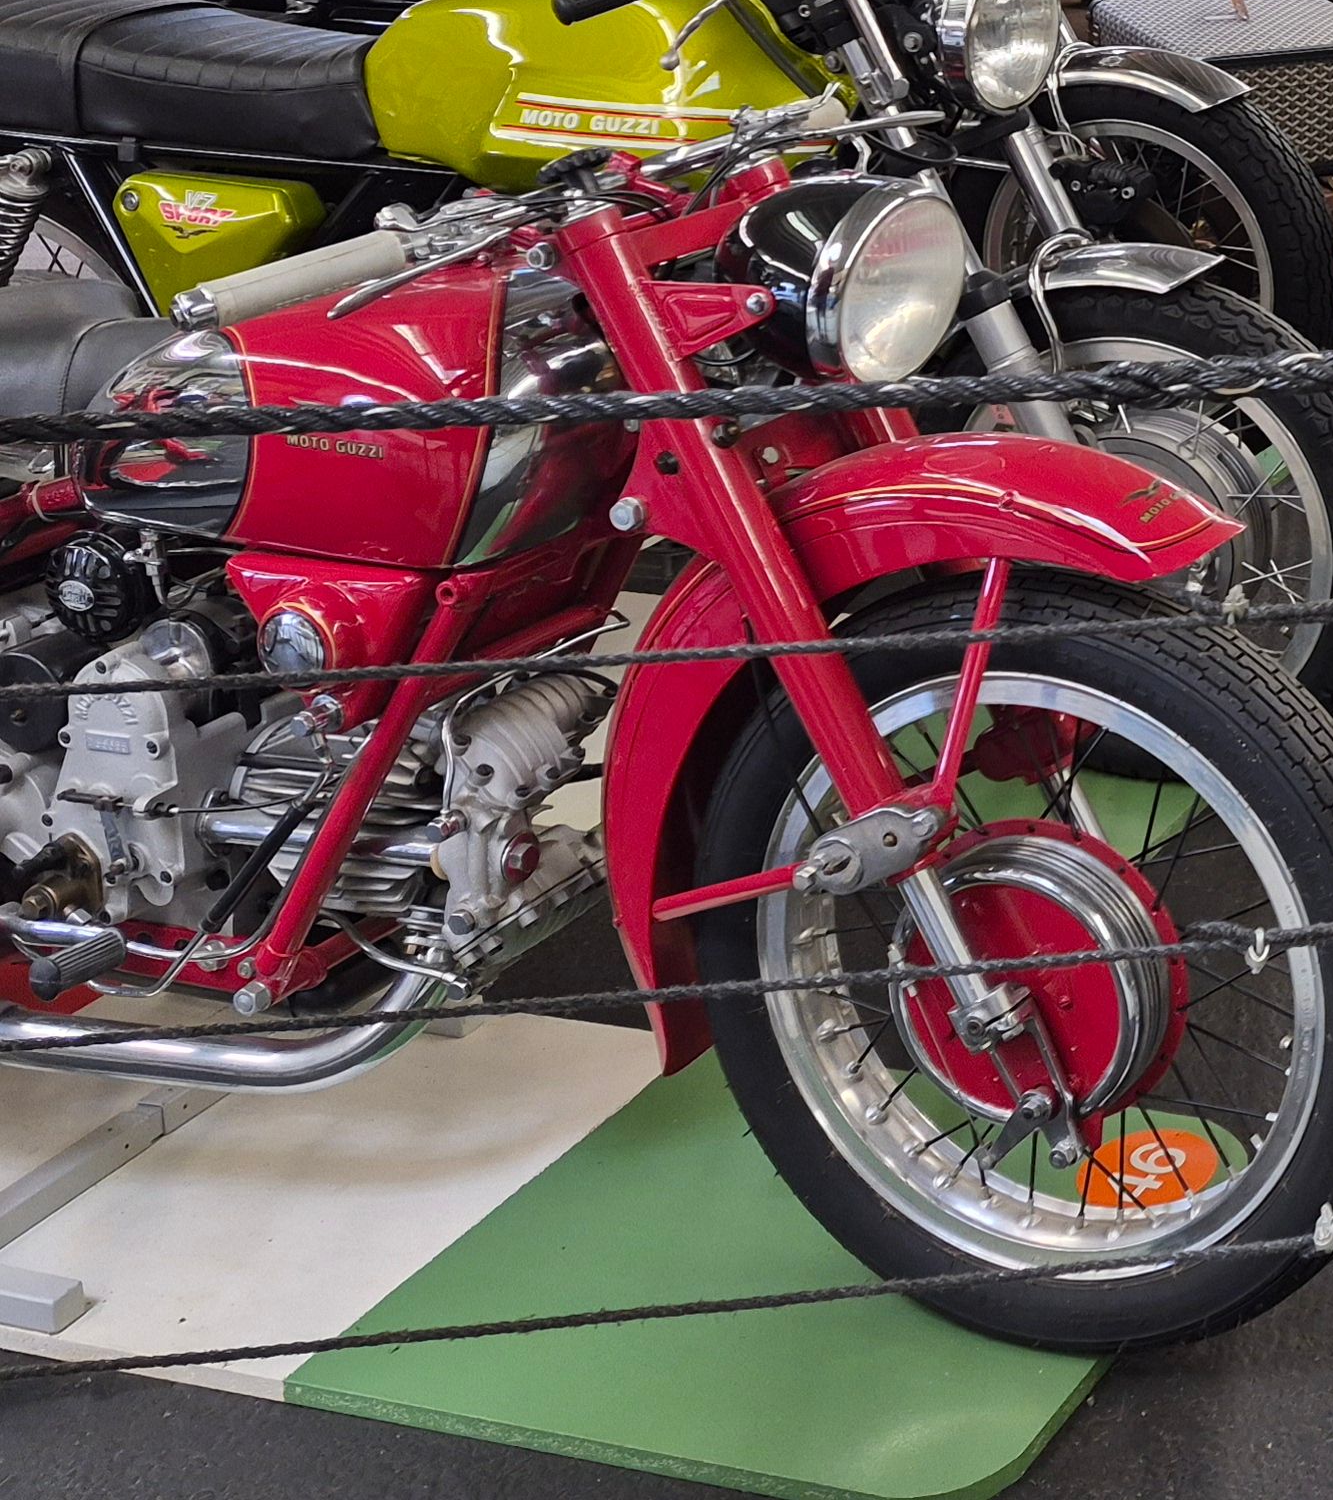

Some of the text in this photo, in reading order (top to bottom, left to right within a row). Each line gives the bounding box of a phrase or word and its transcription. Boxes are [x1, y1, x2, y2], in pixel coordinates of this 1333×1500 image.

[519, 108, 660, 136] MOTO GUZZI
[185, 189, 218, 209] V7
[159, 200, 237, 228] SPORT
[287, 433, 384, 459] MOTO GUZZI
[1106, 1141, 1187, 1202] 46
